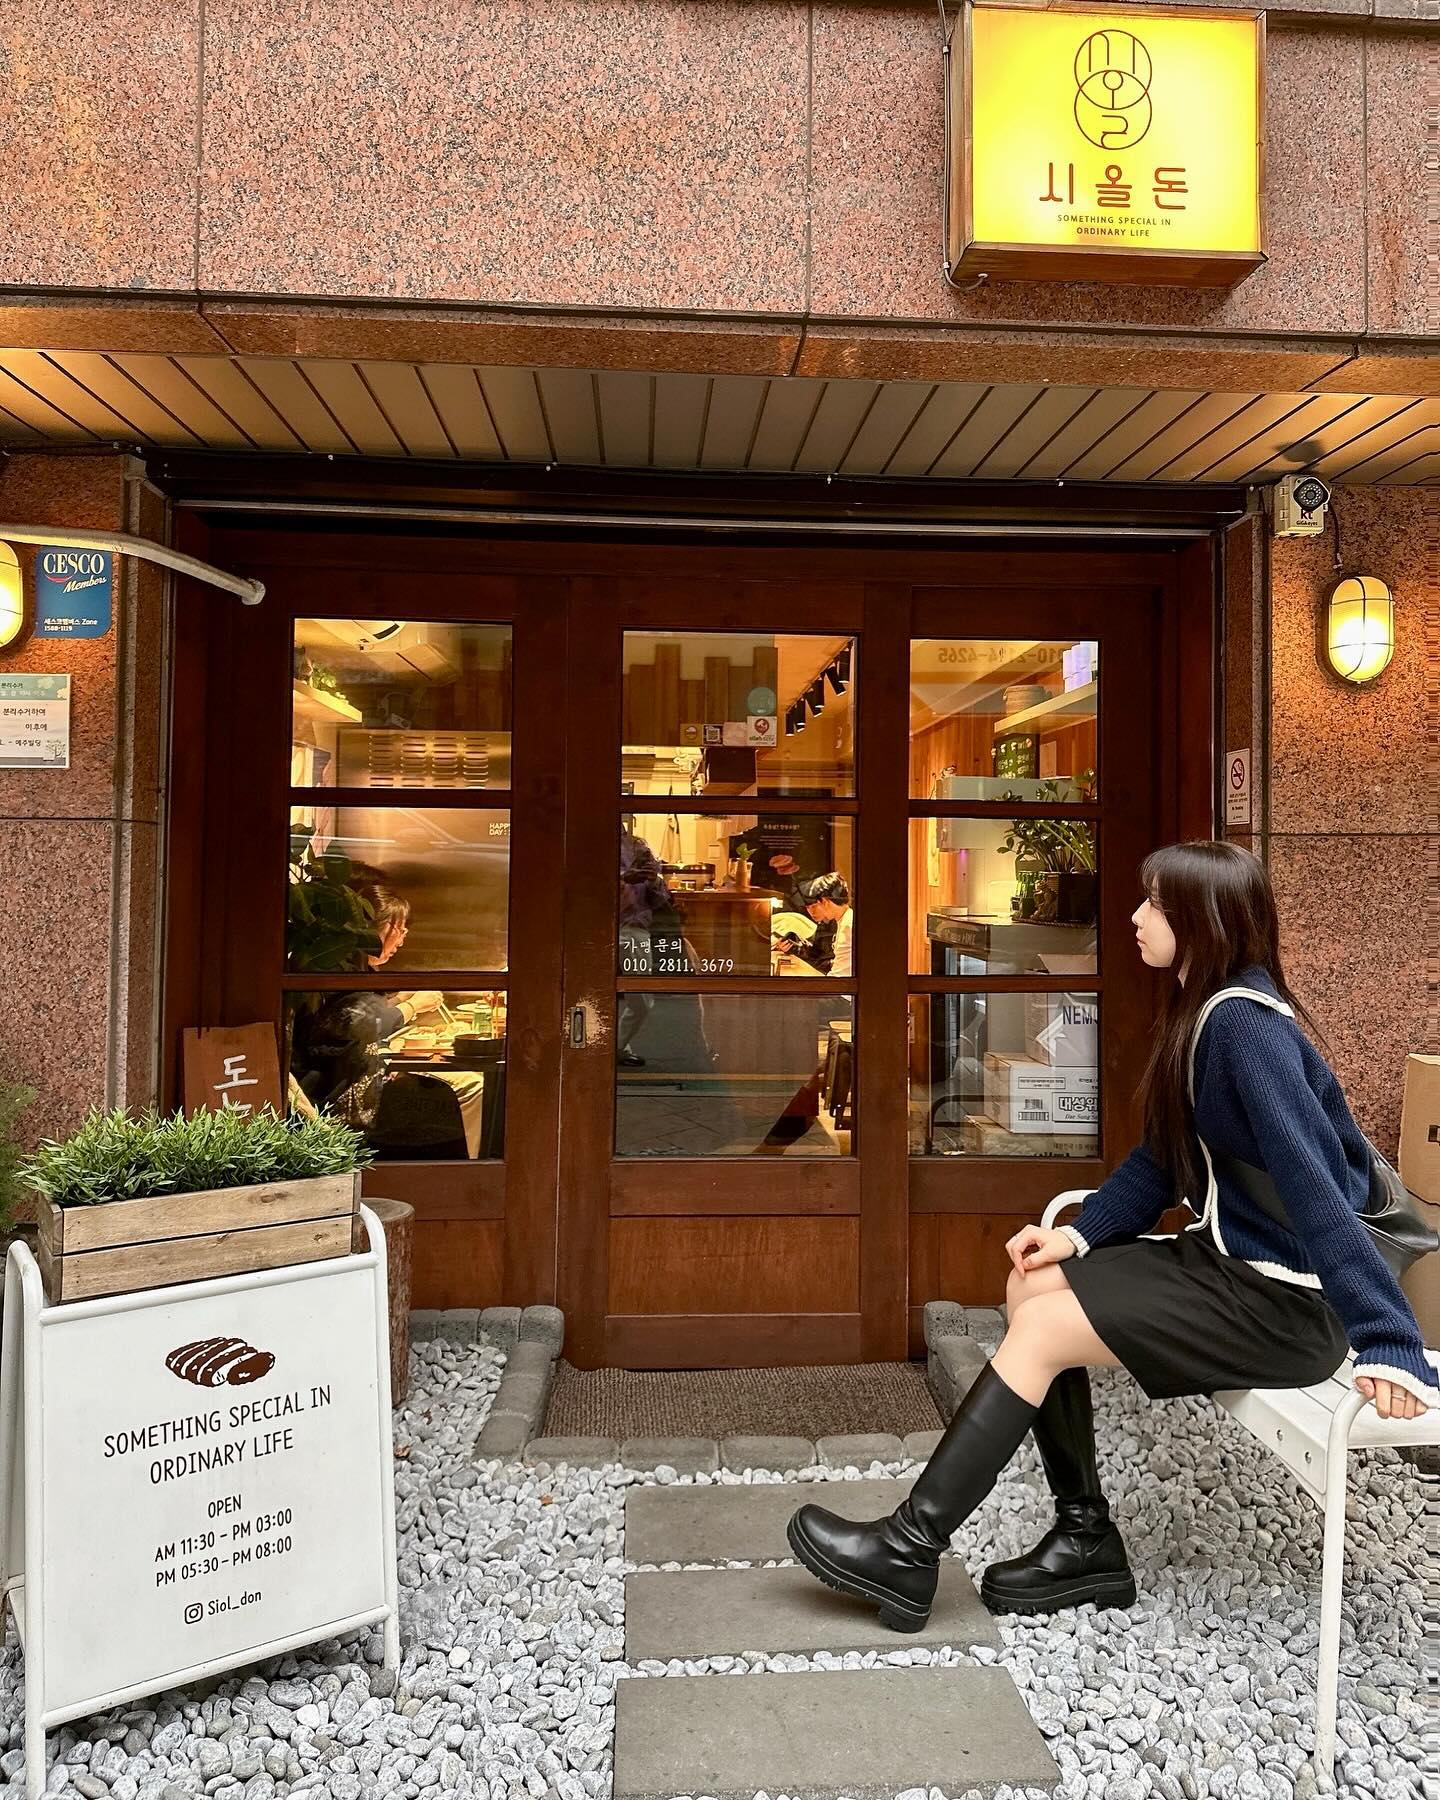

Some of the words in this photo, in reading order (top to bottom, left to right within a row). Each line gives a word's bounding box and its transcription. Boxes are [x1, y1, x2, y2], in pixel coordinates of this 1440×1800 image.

[1057, 214, 1114, 224] SOMETHING
[1118, 216, 1157, 225] SPECIAL
[1161, 218, 1171, 226] IN
[1076, 227, 1126, 236] ORDINARY
[1130, 229, 1150, 237] LIFE
[43, 553, 105, 575] CESCO
[62, 574, 108, 594] Members
[623, 958, 652, 972] 010.
[658, 958, 694, 972] 2811.
[700, 958, 734, 972] 3679
[104, 1410, 221, 1458] SOMETHING
[229, 1391, 305, 1428] SPECIAL
[310, 1384, 331, 1409] IN
[150, 1439, 247, 1484] ORDINARY
[253, 1428, 294, 1458] LIFE
[207, 1494, 242, 1519] OPEN
[155, 1542, 176, 1563] AM
[181, 1531, 215, 1555] 11:30
[232, 1520, 251, 1541] PM
[256, 1508, 292, 1533] 03:00
[156, 1568, 176, 1587] PM
[181, 1557, 219, 1580] 05:30
[232, 1547, 251, 1566] PM
[255, 1535, 292, 1560] 08:00
[207, 1591, 262, 1616] Siol_don
